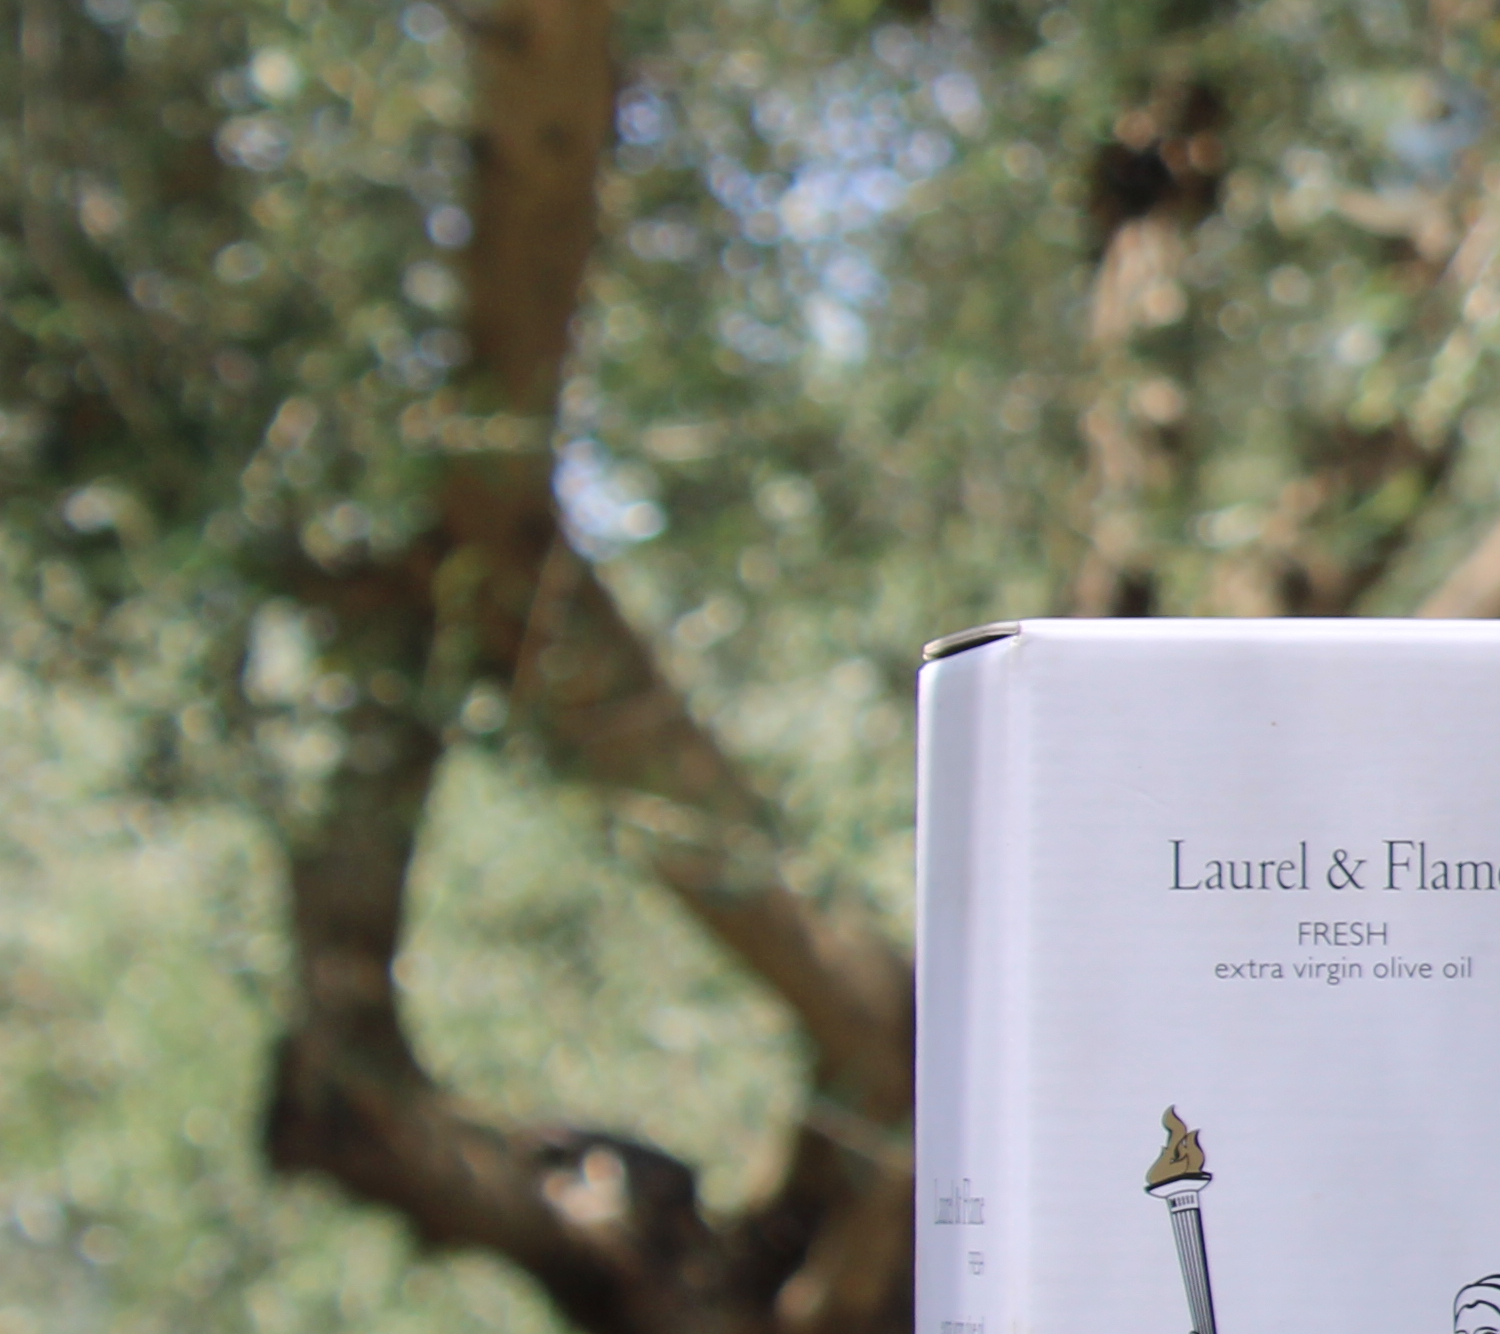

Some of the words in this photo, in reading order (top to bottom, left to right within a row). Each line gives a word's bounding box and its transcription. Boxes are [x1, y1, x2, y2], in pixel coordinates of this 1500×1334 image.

[1167, 838, 1308, 894] Laurel
[1326, 847, 1365, 892] &
[1297, 921, 1388, 947] FRESH
[1214, 957, 1284, 981] extra
[1294, 955, 1363, 985] virgin
[1373, 955, 1433, 981] olive
[1443, 955, 1472, 981] oil
